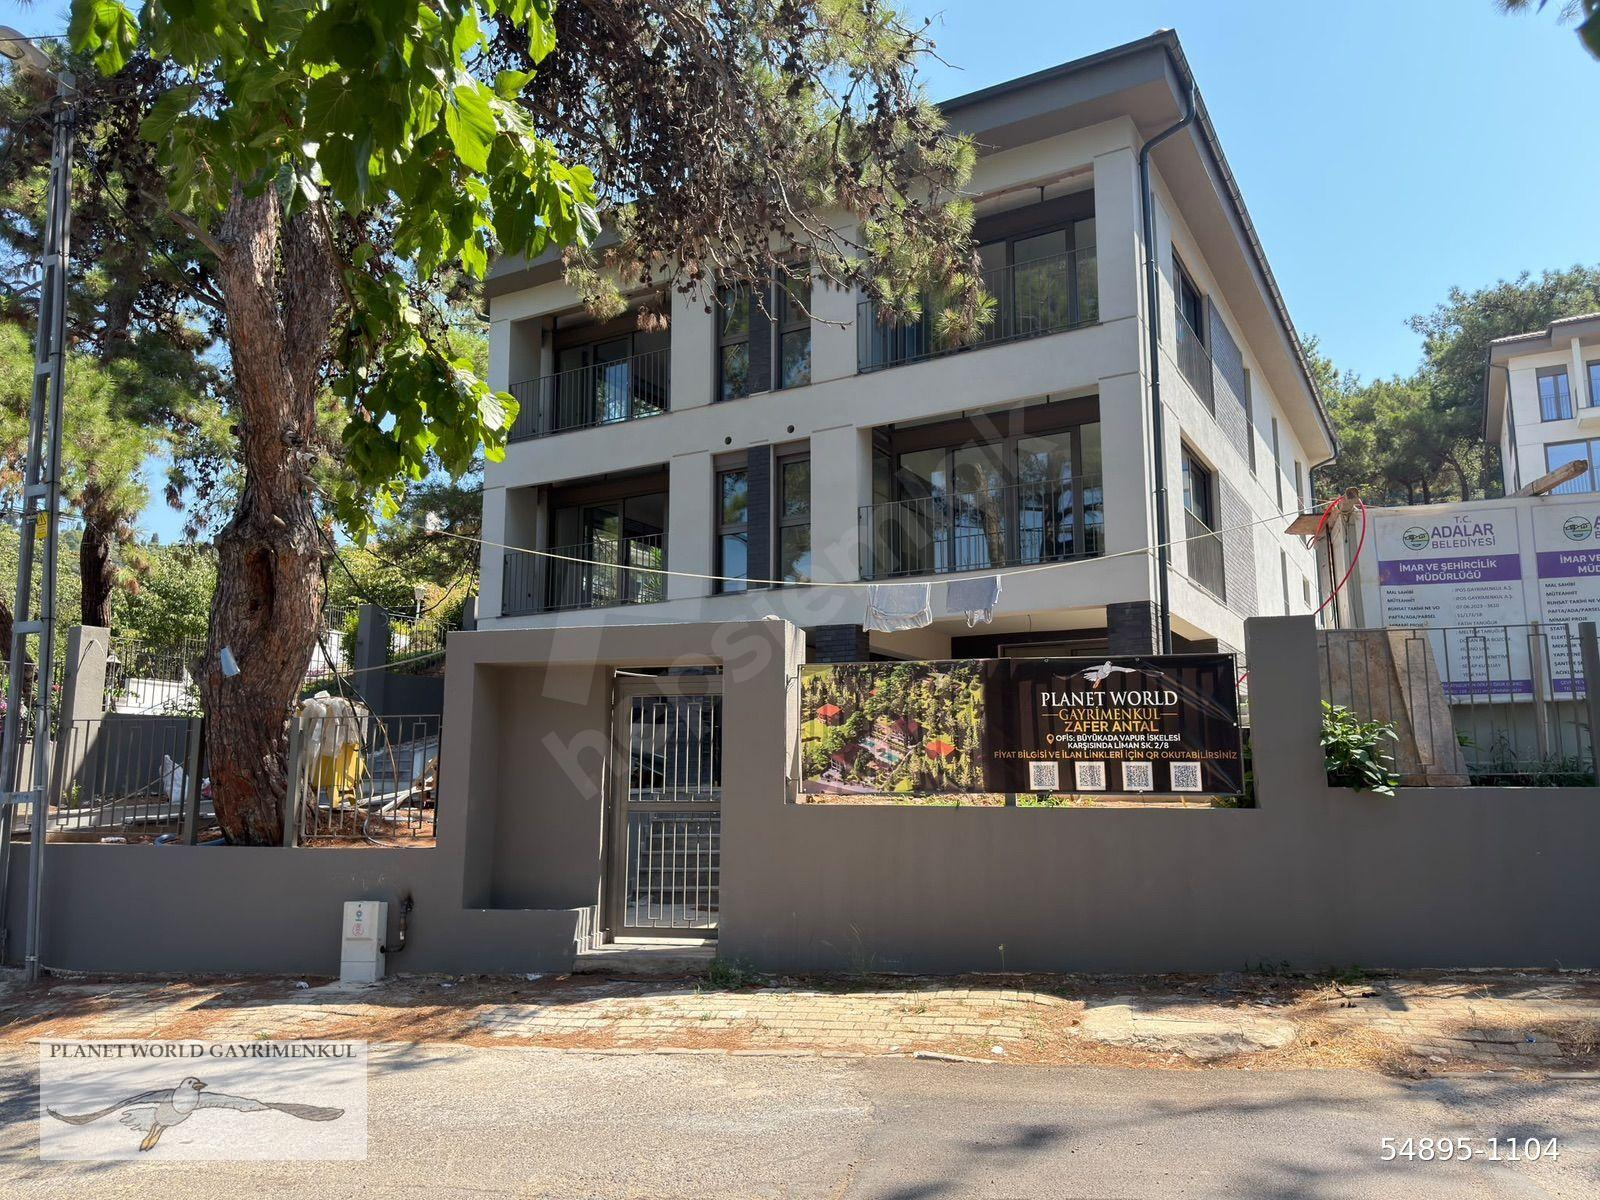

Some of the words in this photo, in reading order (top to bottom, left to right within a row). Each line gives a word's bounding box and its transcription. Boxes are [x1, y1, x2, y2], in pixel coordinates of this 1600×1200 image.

[1454, 515, 1472, 524] T.C.
[1431, 523, 1494, 538] ADALAR
[1432, 536, 1496, 549] BELEDİYESİ
[1560, 554, 1586, 564] İMAR
[1400, 562, 1424, 572] İMAR
[1425, 563, 1439, 571] VE
[1441, 559, 1497, 571] ŞEHİRCİLİK
[1416, 570, 1481, 582] MÜDÜRLÜĞÜ
[1041, 692, 1106, 706] PLANET
[1110, 690, 1178, 706] WORLD
[1059, 706, 1160, 720] GAYRİMENKUL
[1064, 721, 1109, 732] ZAFER
[1112, 721, 1159, 732] ANTAL
[1056, 734, 1076, 742] OFİS:
[1076, 733, 1118, 742] BÜYÜKADA
[1147, 733, 1180, 742] İSKELESİ
[994, 750, 1016, 758] FİYAT
[1018, 750, 1047, 758] BİLGİSİ
[1062, 750, 1082, 758] İLAN
[1085, 750, 1123, 758] LİNKLERİ
[1125, 750, 1144, 760] İÇİN
[1161, 750, 1237, 759] OKUTABİLİRSİNİZ
